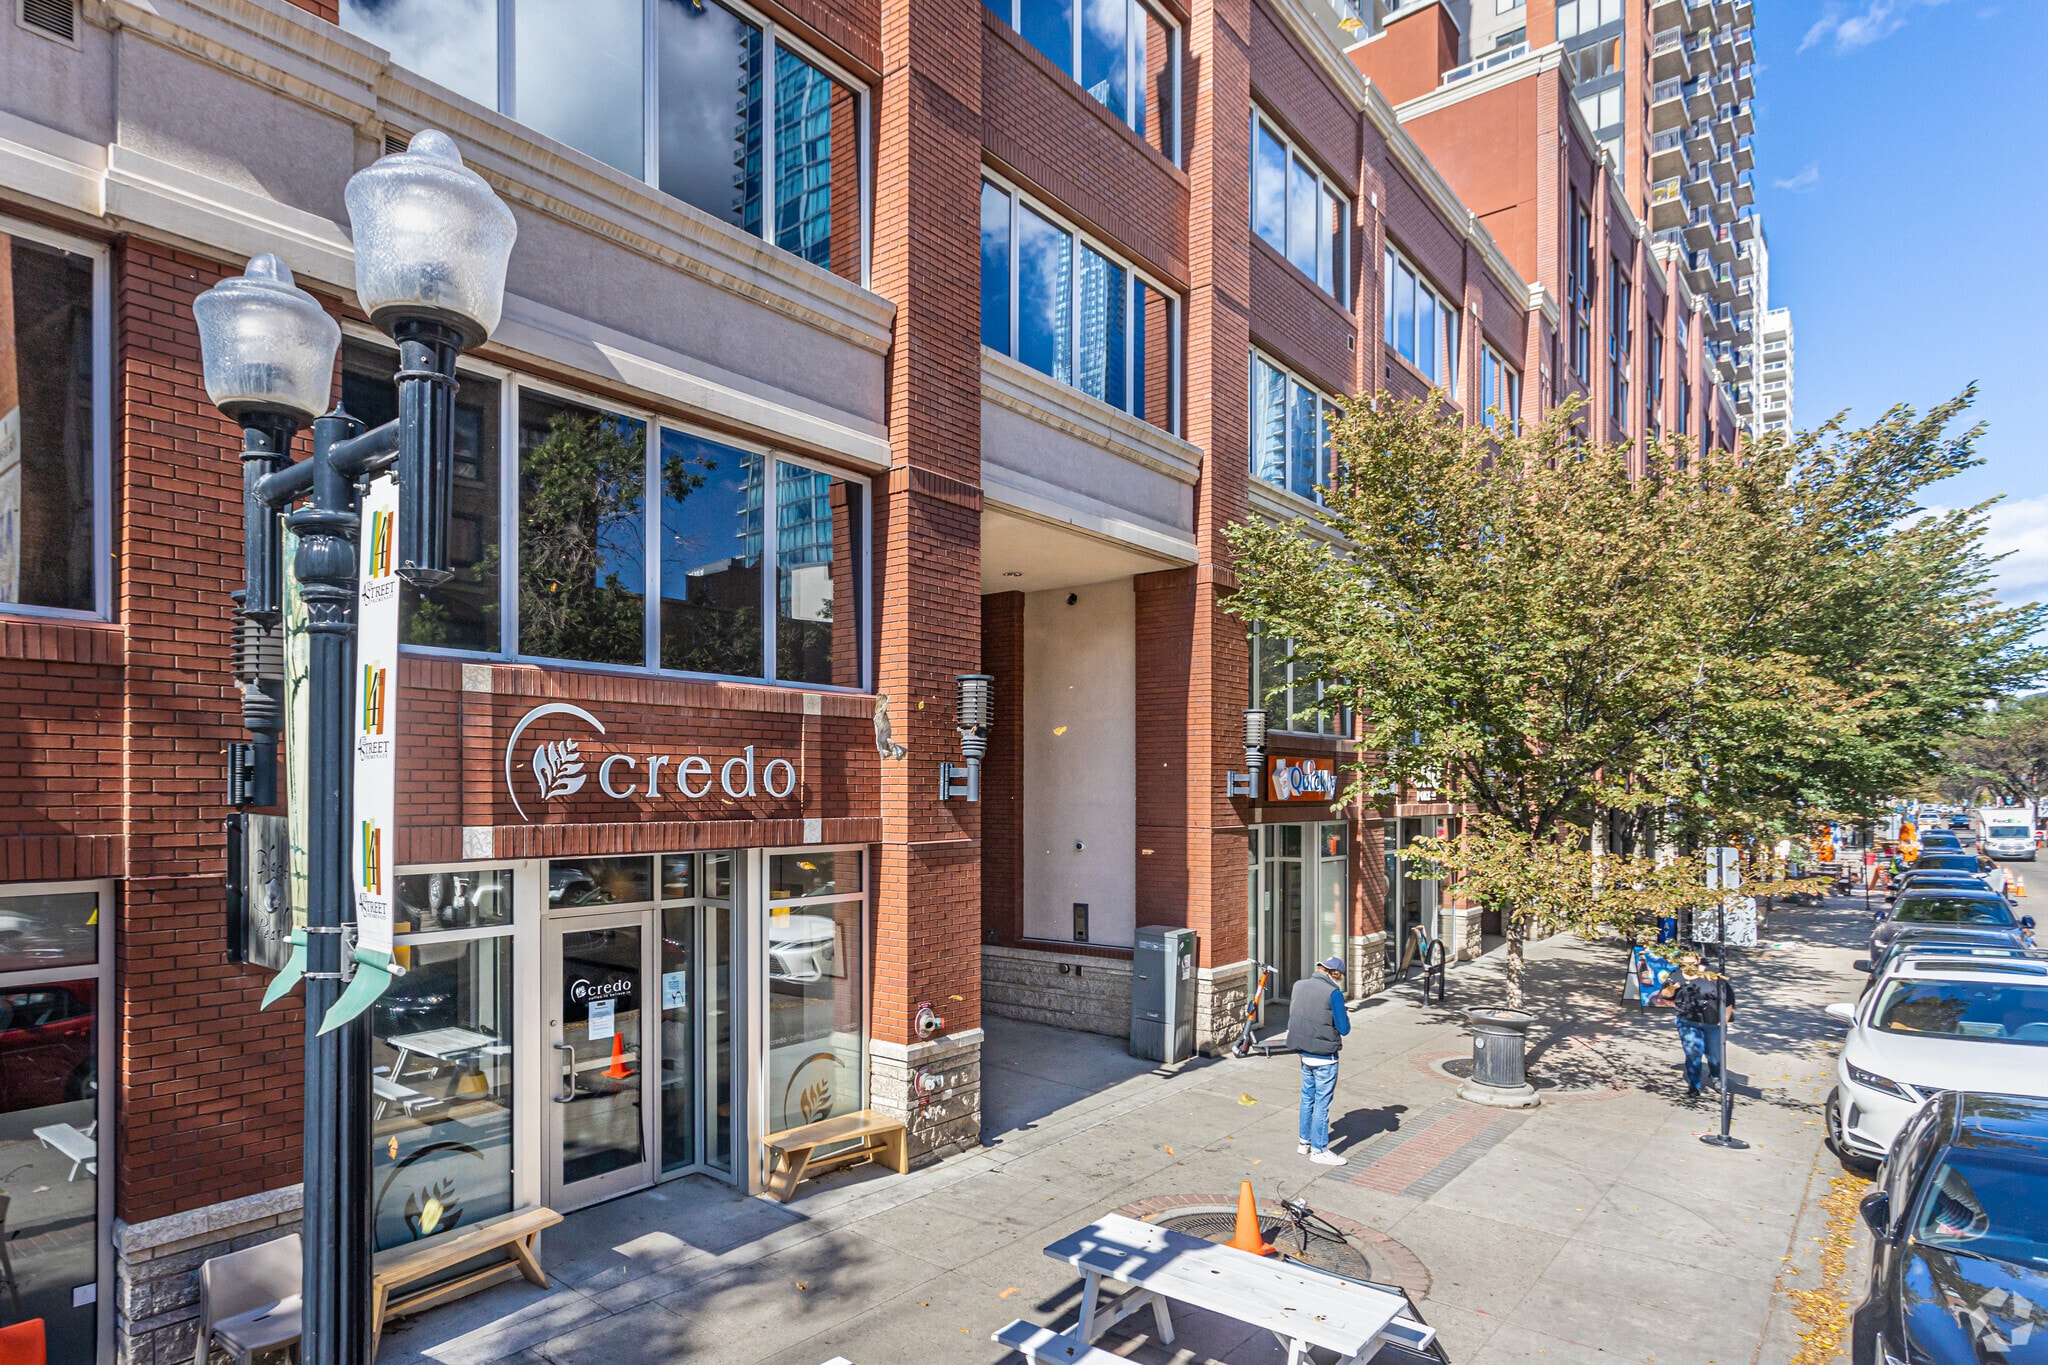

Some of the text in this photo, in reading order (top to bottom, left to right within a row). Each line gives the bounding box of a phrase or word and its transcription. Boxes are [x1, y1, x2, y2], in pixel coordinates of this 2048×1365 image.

[365, 581, 395, 606] STREET
[361, 741, 389, 761] STREET
[599, 745, 796, 799] credo
[362, 900, 387, 917] STREET
[588, 980, 631, 996] credo
